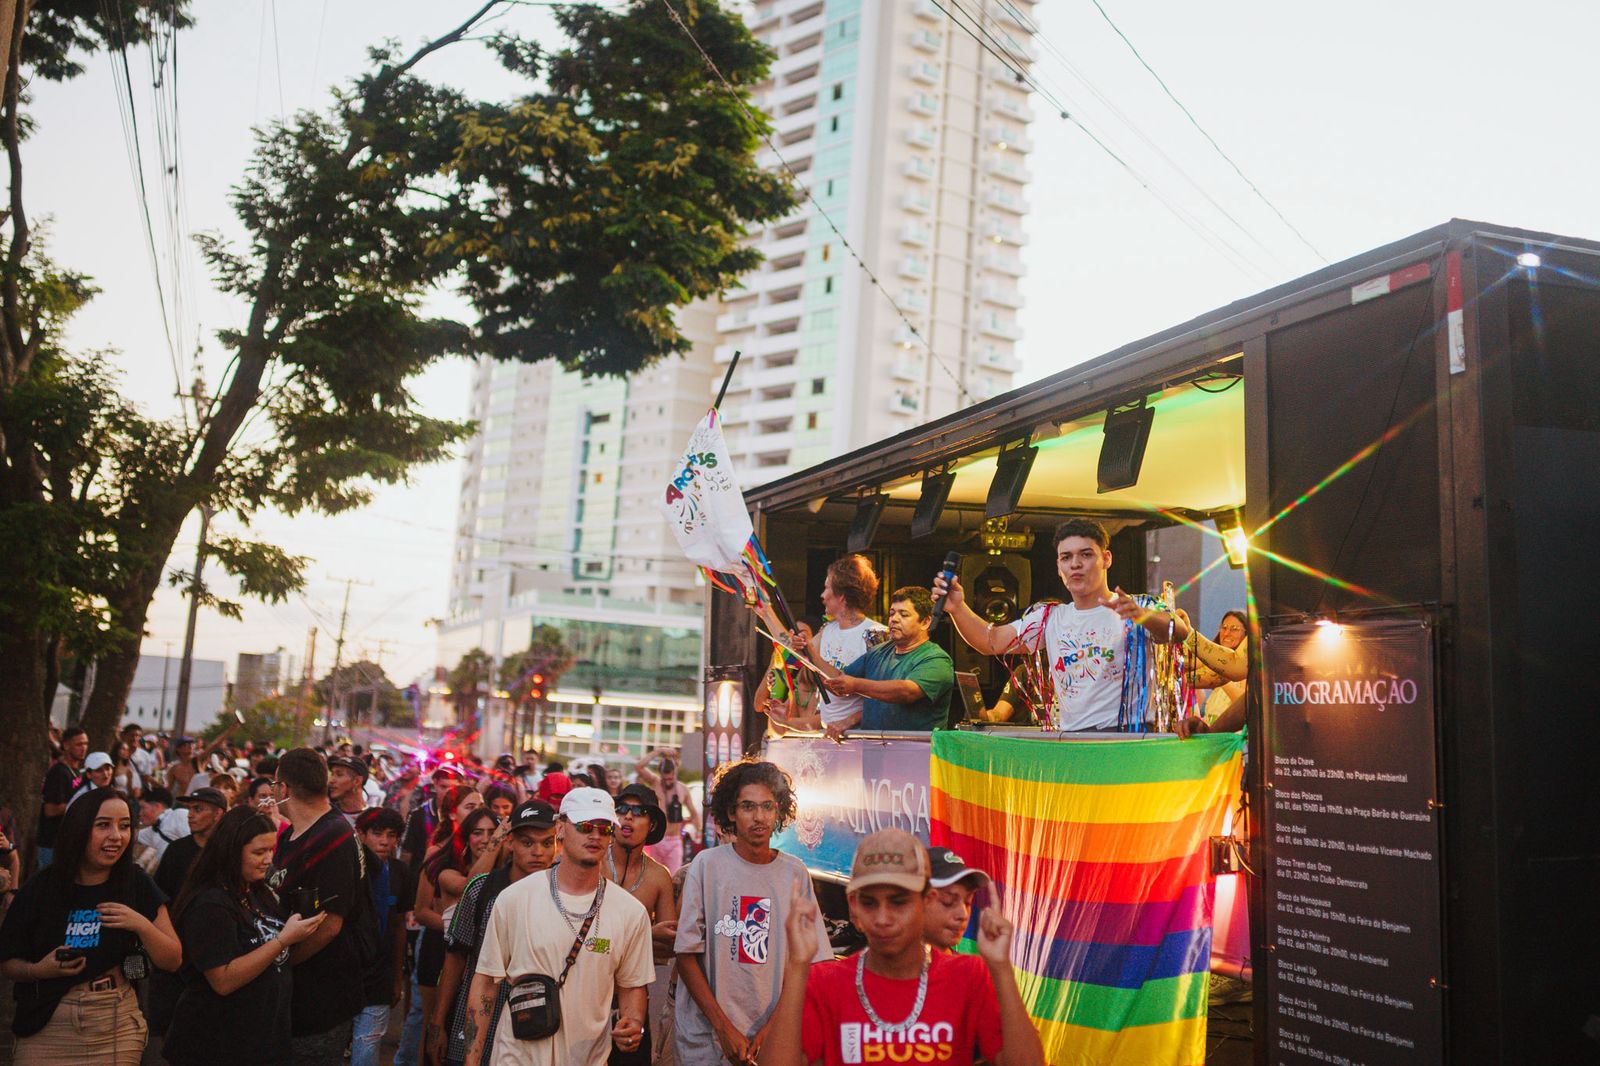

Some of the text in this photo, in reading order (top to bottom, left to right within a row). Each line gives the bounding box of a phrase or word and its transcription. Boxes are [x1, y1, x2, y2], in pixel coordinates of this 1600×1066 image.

[1055, 646, 1115, 672] ARCO IRIS
[1273, 674, 1417, 712] PROGRAMAÇÃO
[1274, 755, 1289, 764] Bloco
[1298, 757, 1314, 766] Chave
[1292, 768, 1302, 776] das
[1319, 769, 1326, 778] às
[1346, 772, 1354, 780] no
[1355, 771, 1376, 782] Parque
[1376, 772, 1408, 782] Ambiental
[1275, 789, 1290, 798] Bloco
[1291, 791, 1301, 800] dos
[1276, 801, 1284, 810] dia
[1292, 802, 1302, 811] das
[1320, 804, 1326, 813] às
[1353, 806, 1370, 818] Praça
[1372, 808, 1390, 818] Barão
[1390, 810, 1398, 819] de
[1276, 824, 1291, 832] Bloco
[1276, 836, 1284, 844] dia
[1293, 836, 1302, 846] das
[1320, 838, 1327, 848] às
[1356, 844, 1378, 854] Avenida
[1380, 846, 1402, 857] Vicente
[1404, 849, 1432, 860] Machado
[1276, 857, 1332, 872] Bloco Trem das Onze
[1276, 869, 1285, 878] dia
[1320, 874, 1336, 884] Clube
[1336, 876, 1368, 890] Democrata
[1277, 891, 1292, 901] Bloco
[1300, 895, 1332, 908] Menopausa
[1277, 903, 1286, 912] dia
[1295, 906, 1305, 914] das
[1356, 916, 1372, 927] Feira
[1382, 920, 1411, 934] Benjamin
[65, 922, 102, 936] HIGH
[1277, 925, 1293, 936] Bloco
[64, 935, 100, 949] HIGH
[1278, 938, 1286, 946] dia
[1296, 940, 1306, 950] das
[1359, 952, 1389, 967] Ambiental
[1278, 960, 1318, 976] Bloco Level Up
[1278, 971, 1286, 980] dia
[1296, 974, 1306, 984] das
[1360, 988, 1375, 1001] Feira
[1384, 994, 1414, 1010] Benjamin
[1278, 994, 1294, 1004] Bloco
[1294, 998, 1307, 1008] Arco
[1278, 1006, 1287, 1015] dia
[1296, 1010, 1306, 1020] das
[1360, 1026, 1376, 1038] Feira
[863, 1021, 954, 1043] HUGO
[1279, 1028, 1294, 1040] Bloco
[864, 1043, 954, 1063] BOSS
